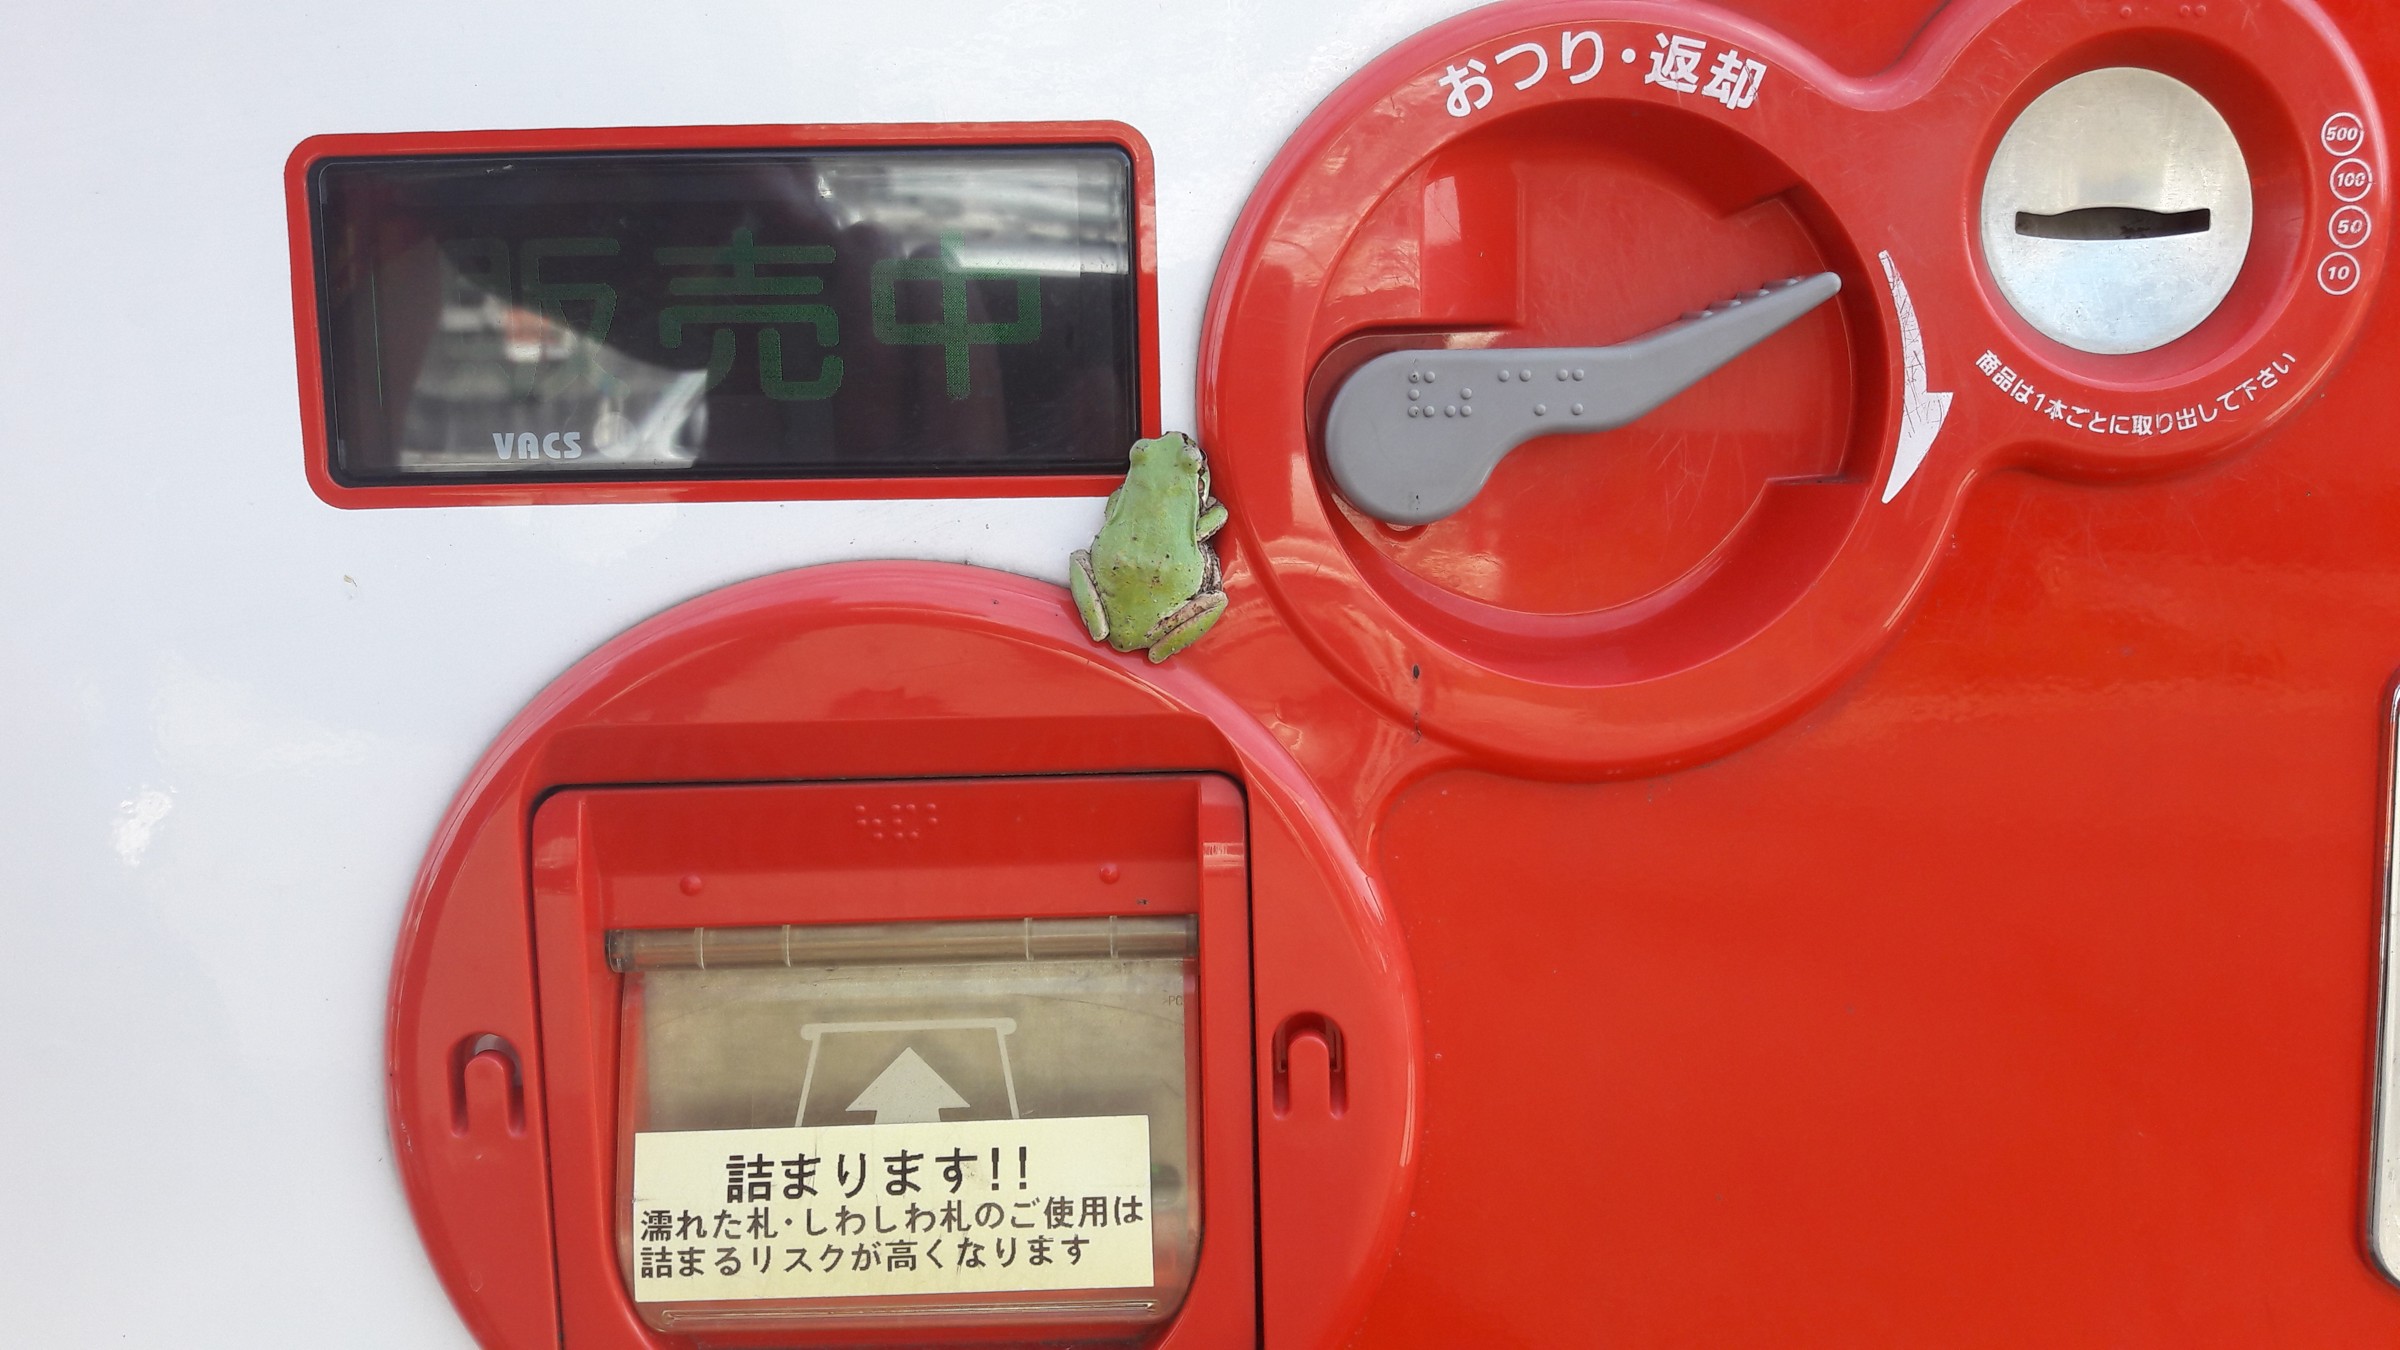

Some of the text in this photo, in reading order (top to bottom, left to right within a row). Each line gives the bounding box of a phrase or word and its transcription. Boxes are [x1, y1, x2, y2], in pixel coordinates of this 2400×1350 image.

[1438, 31, 1767, 117] おつり・返却
[2326, 127, 2358, 141] 500
[2337, 172, 2365, 187] 100
[2337, 219, 2363, 234] 50
[2328, 265, 2350, 280] 10
[441, 226, 1042, 402] 販売中
[1975, 349, 2296, 436] 商品は1本ごとに取り出して下さい
[493, 432, 582, 460] VACS
[640, 1195, 1143, 1242] 濡れた札・しわしわ札のご使用は
[640, 1235, 1090, 1279] 詰まるリスクが高くなります
